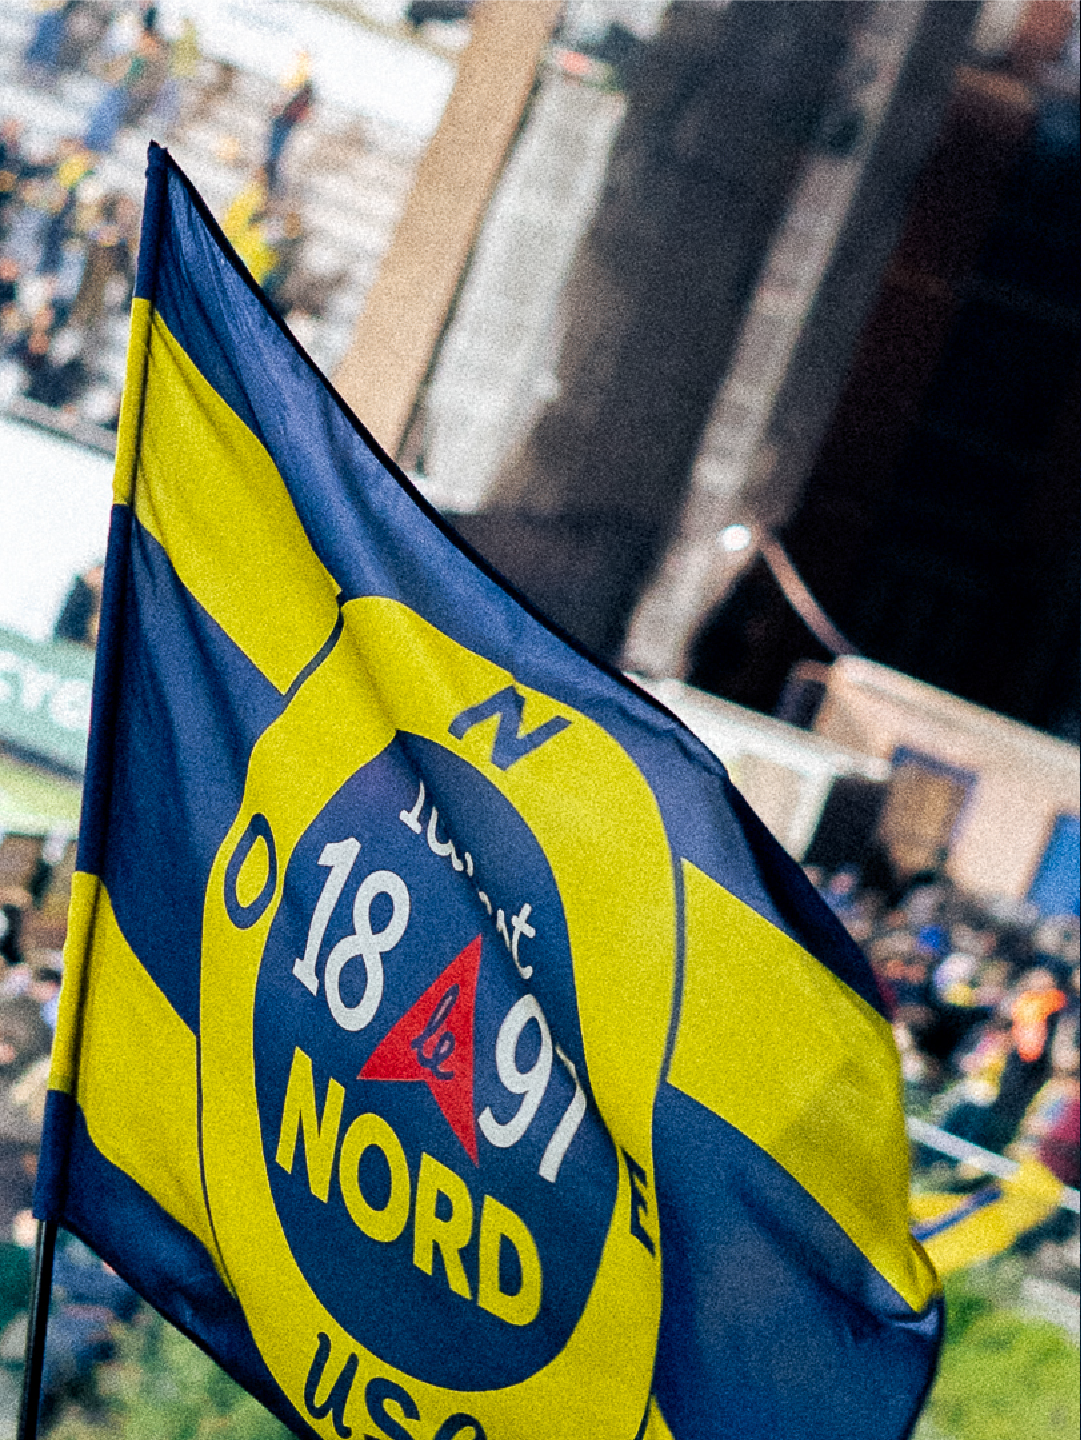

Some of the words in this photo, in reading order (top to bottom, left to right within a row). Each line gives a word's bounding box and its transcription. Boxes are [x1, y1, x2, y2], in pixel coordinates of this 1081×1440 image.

[292, 837, 411, 1032] 18
[478, 993, 588, 1183] 97
[275, 1046, 543, 1326] NORD
